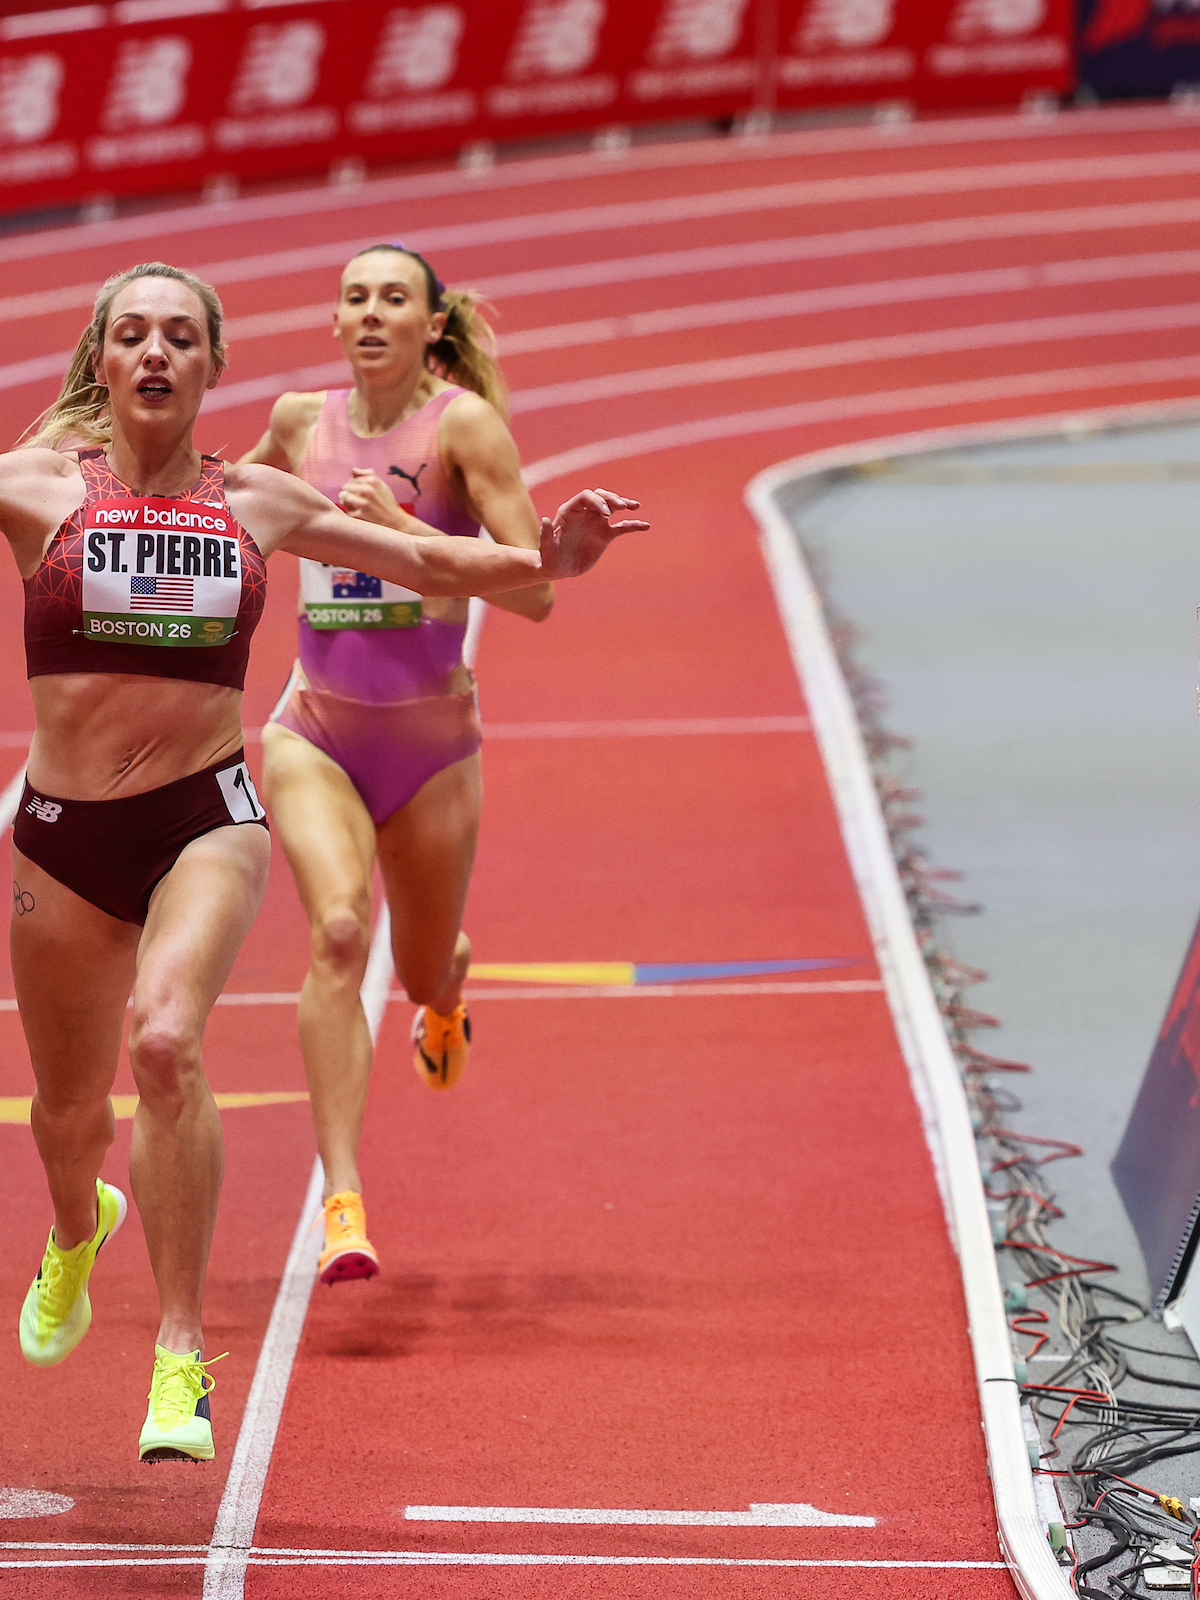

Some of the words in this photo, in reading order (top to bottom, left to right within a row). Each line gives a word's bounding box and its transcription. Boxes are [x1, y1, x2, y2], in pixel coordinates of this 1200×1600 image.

[95, 507, 139, 524] new
[144, 505, 228, 532] balance
[87, 531, 128, 573] ST.
[136, 533, 238, 579] PIERRE
[90, 618, 164, 638] BOSTON
[167, 622, 192, 639] 26
[307, 608, 361, 623] OSTON
[361, 608, 383, 623] 26
[233, 767, 258, 818] 1
